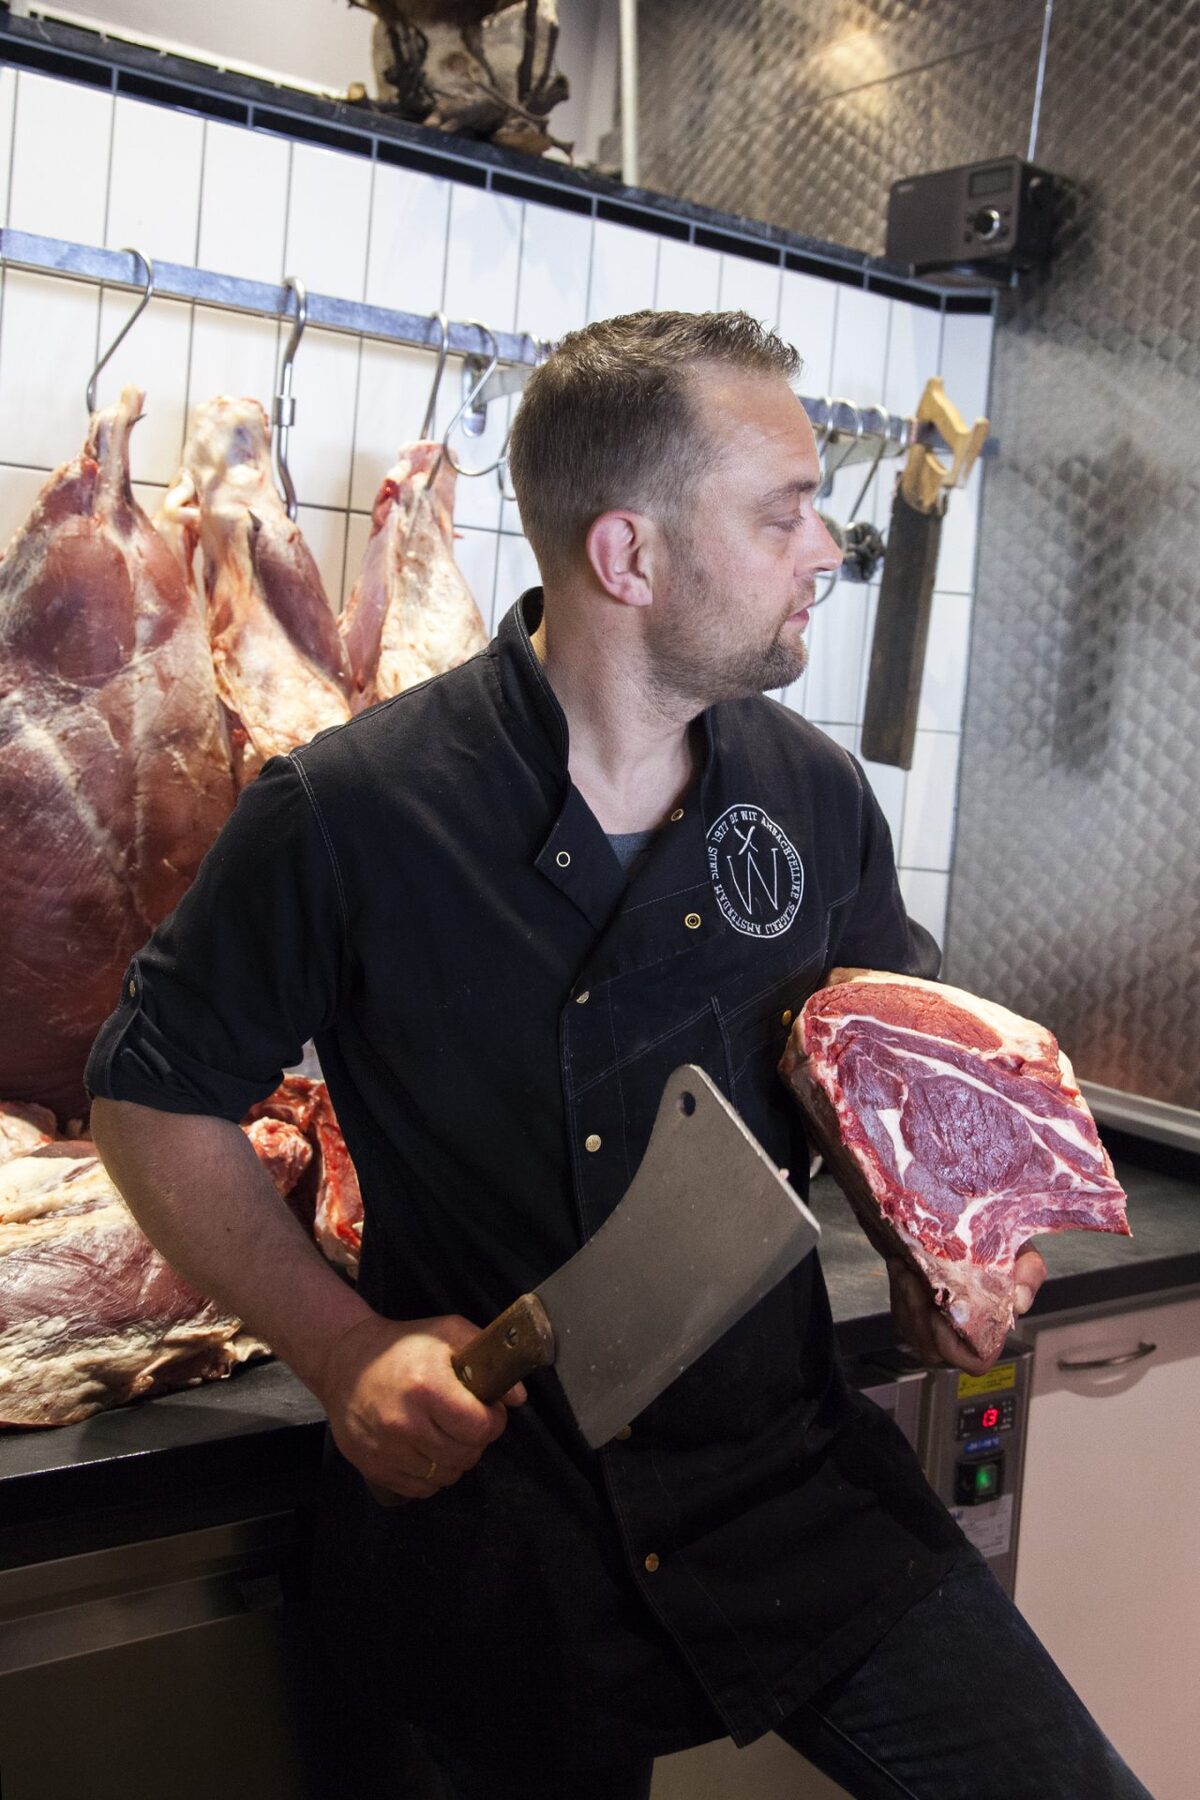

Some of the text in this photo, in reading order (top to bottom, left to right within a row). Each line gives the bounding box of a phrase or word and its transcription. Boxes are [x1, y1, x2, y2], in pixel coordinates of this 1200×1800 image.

[711, 820, 729, 843] 1977
[740, 810, 758, 822] WIT
[760, 816, 801, 900] AMBACHTELIJKE
[713, 883, 761, 935] AMSTERDAM
